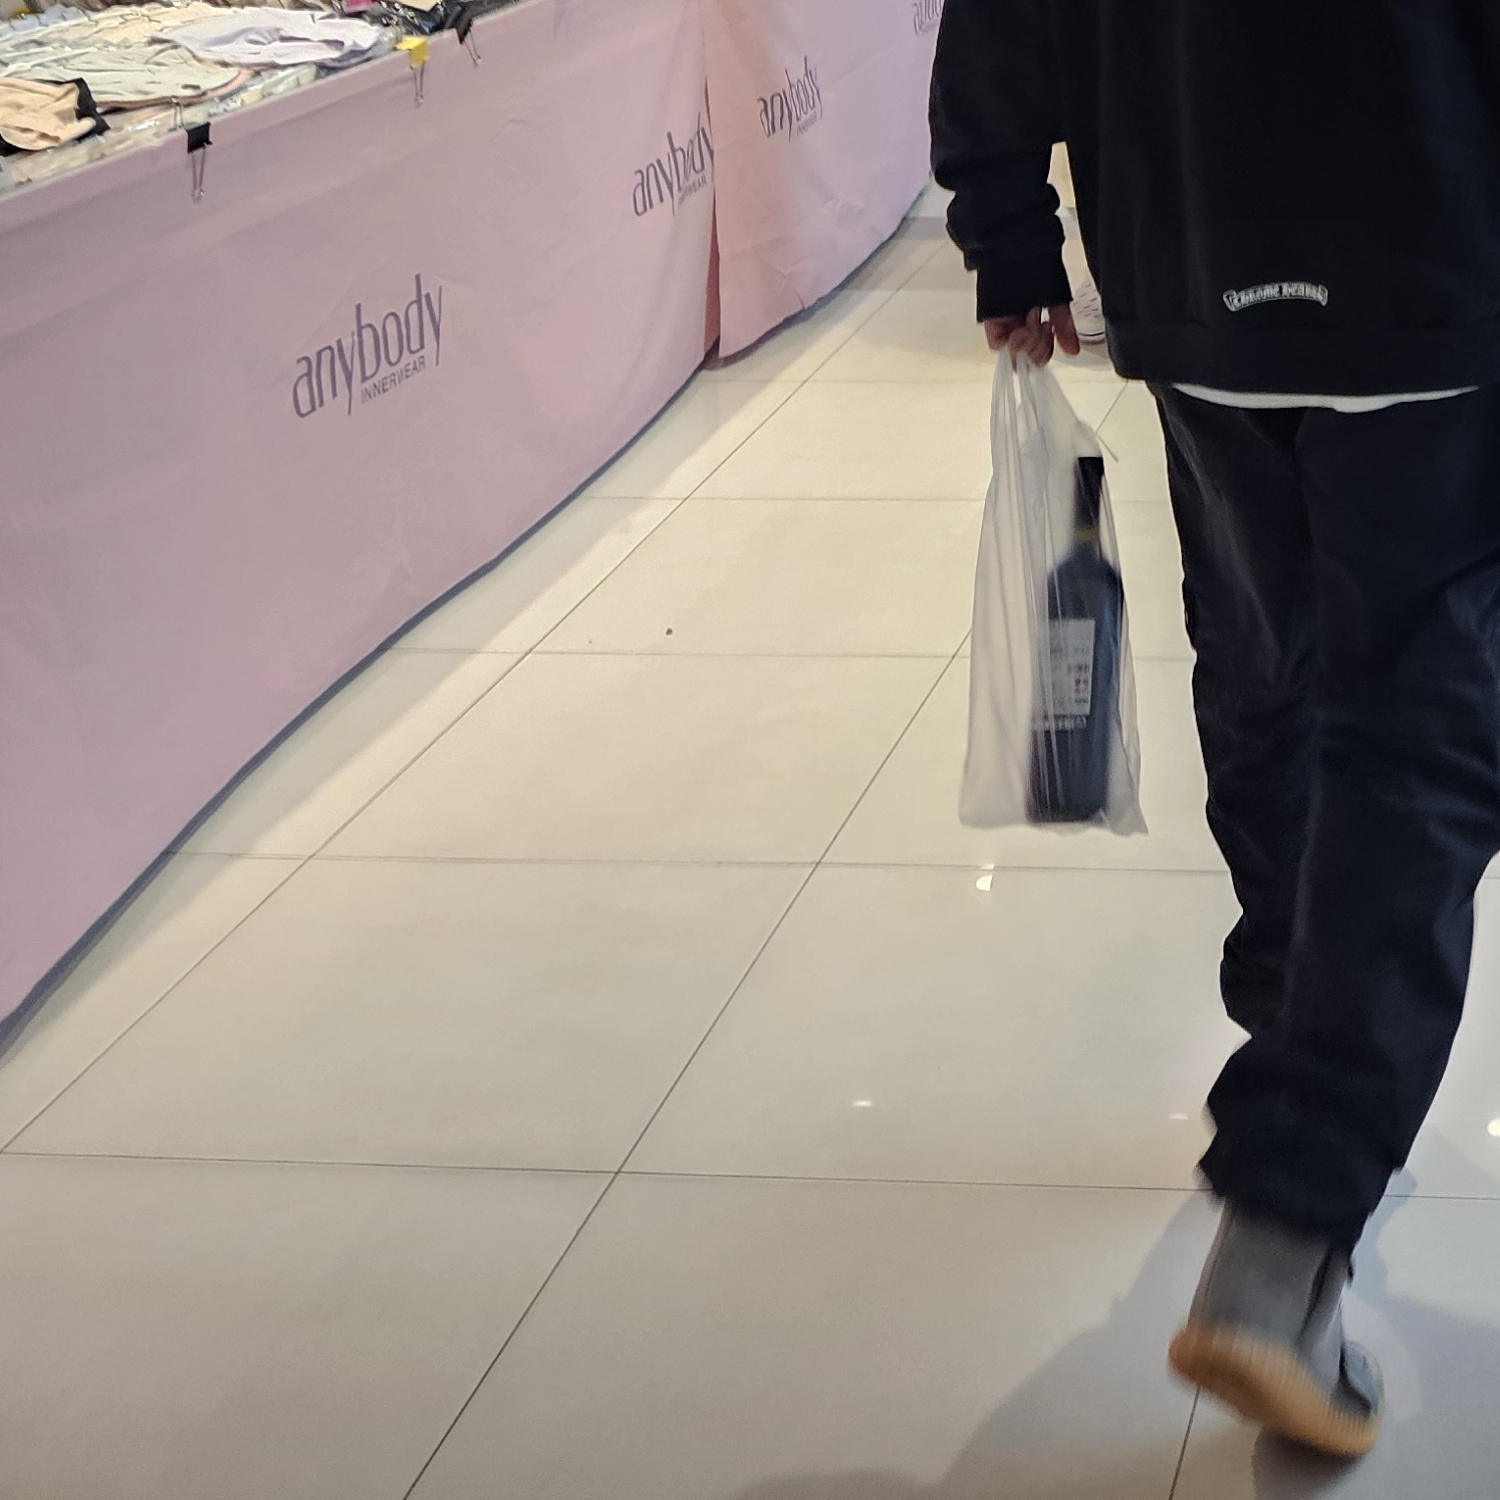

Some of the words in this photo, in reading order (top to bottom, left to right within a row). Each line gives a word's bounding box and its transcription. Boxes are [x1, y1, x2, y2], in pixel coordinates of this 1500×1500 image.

[757, 55, 822, 142] anybody
[292, 273, 442, 419] anybody
[361, 355, 427, 405] INNERWEAR
